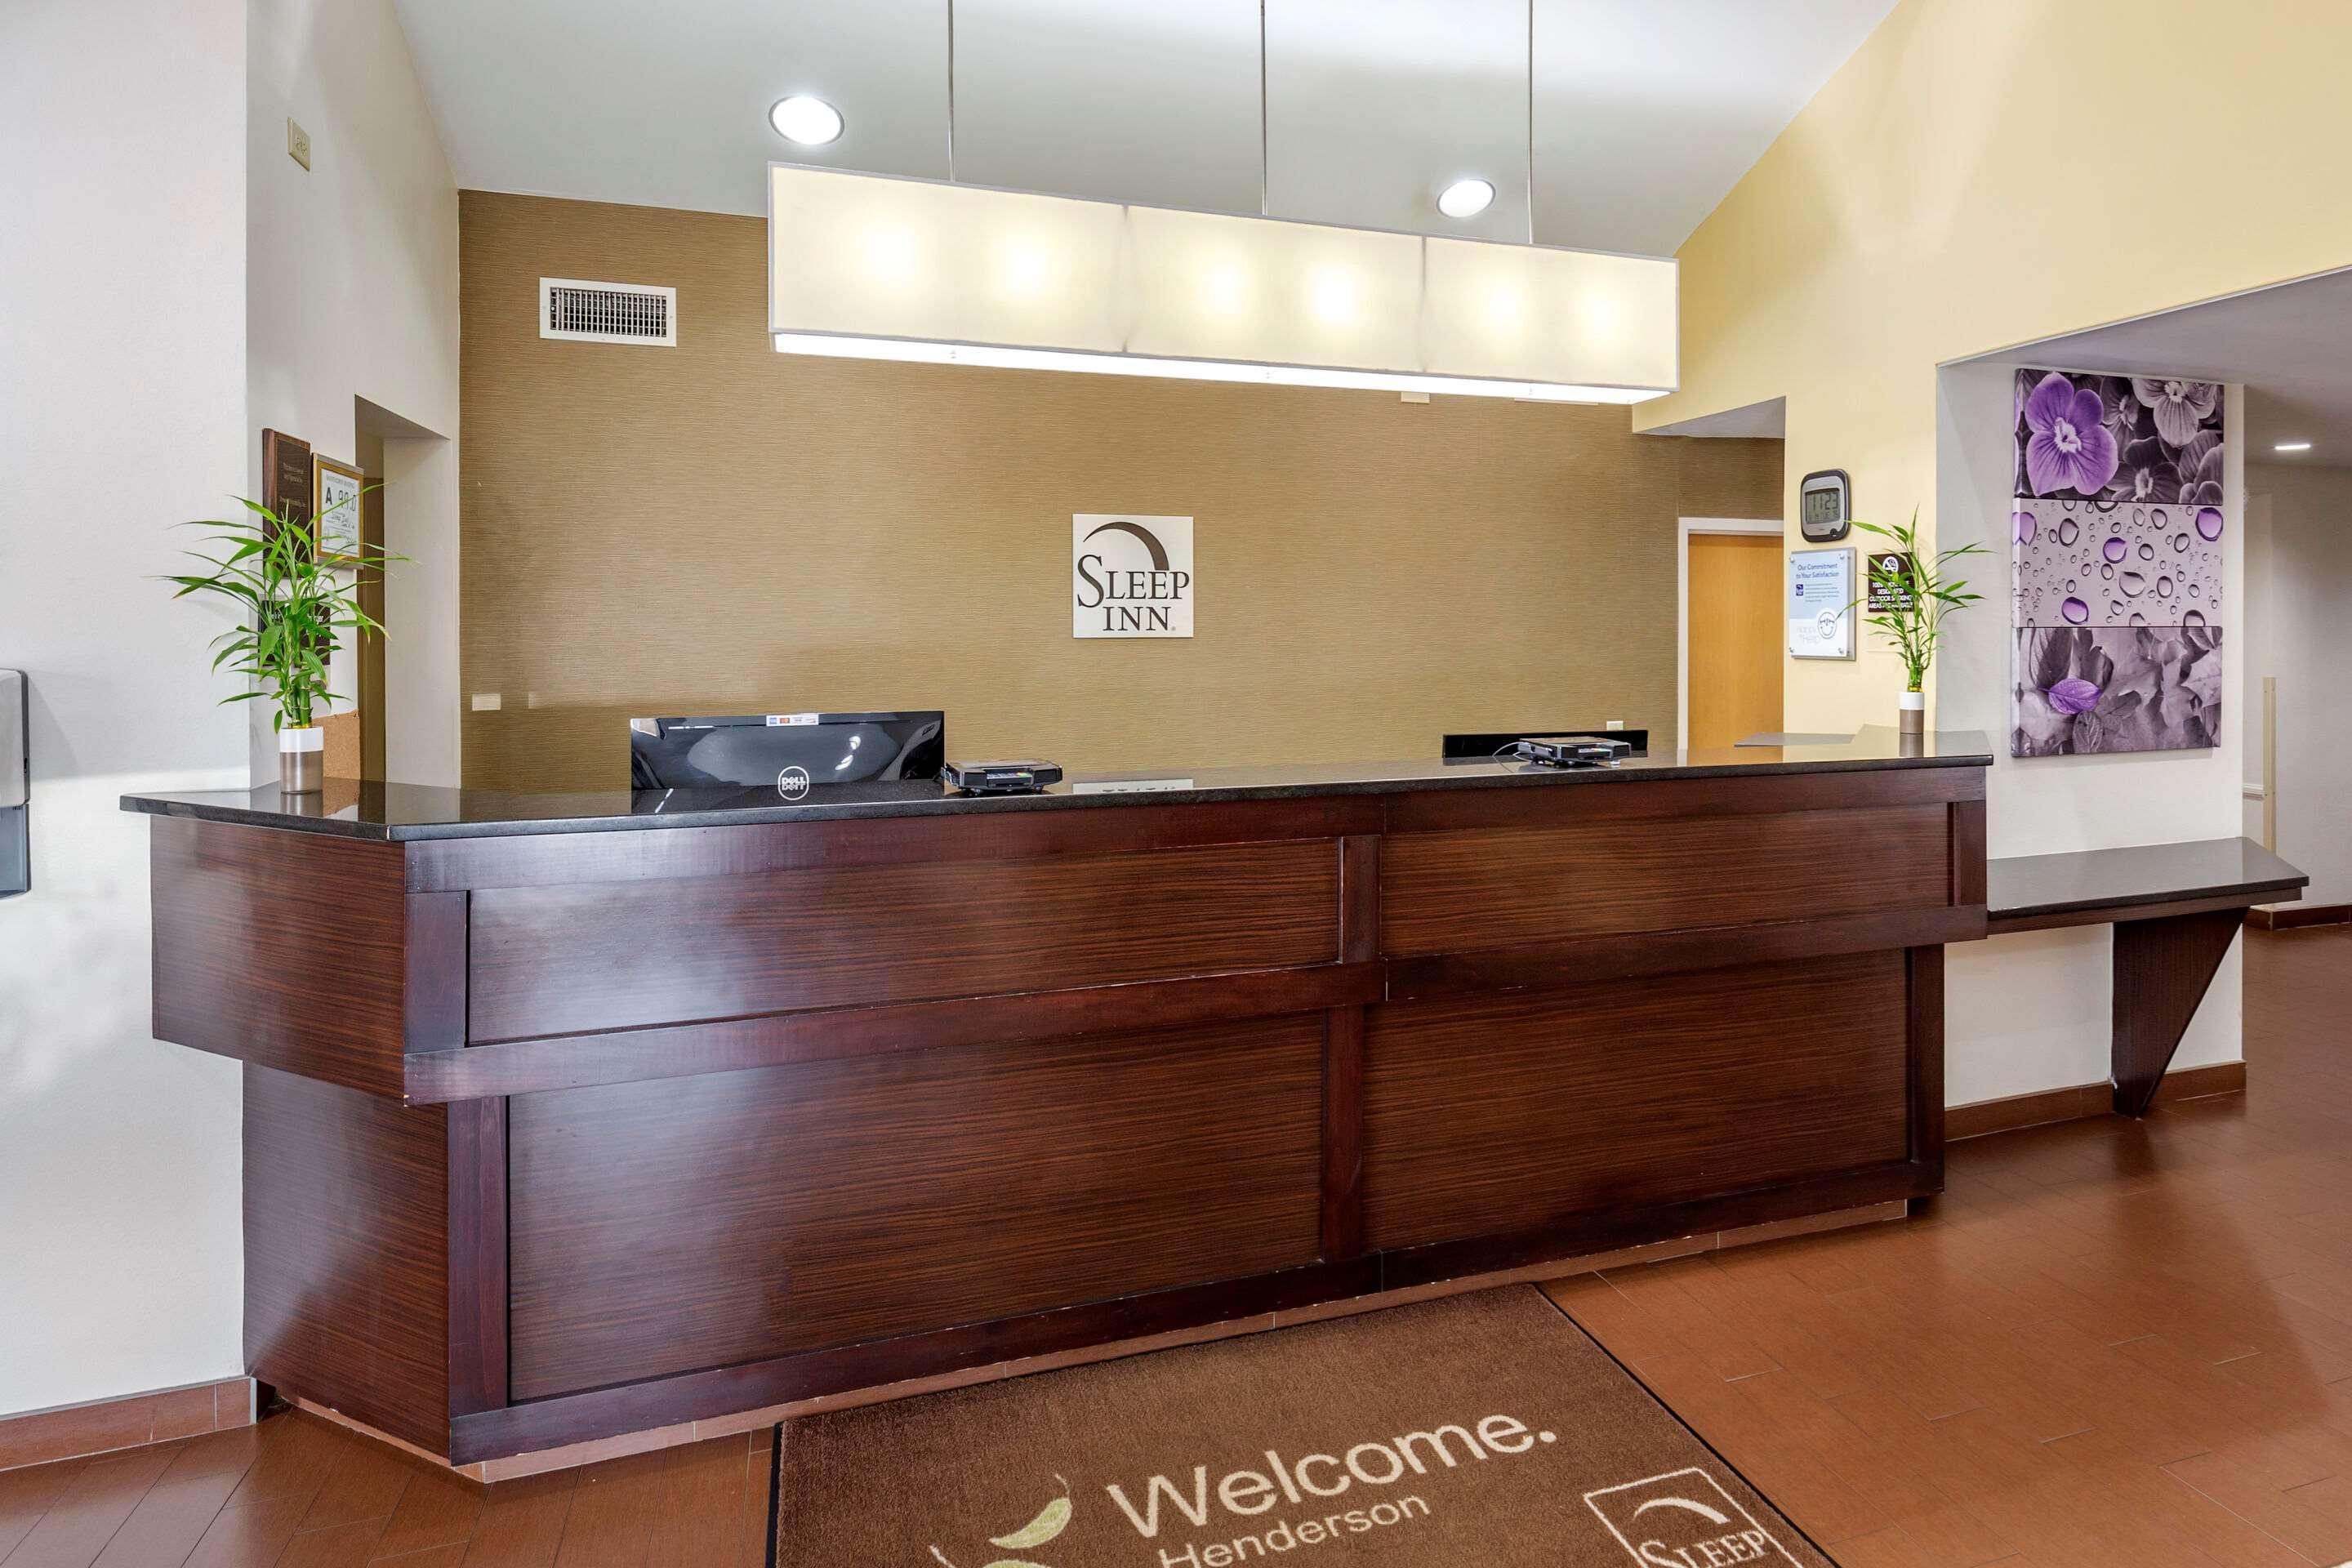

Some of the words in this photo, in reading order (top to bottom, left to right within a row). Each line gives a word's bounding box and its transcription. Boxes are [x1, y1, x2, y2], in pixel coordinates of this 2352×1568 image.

[325, 487, 332, 506] A
[1077, 554, 1190, 608] SLEEP
[1102, 606, 1171, 631] INN
[1107, 1414, 1557, 1539] Welcome.
[1159, 1494, 1431, 1568] Henderson
